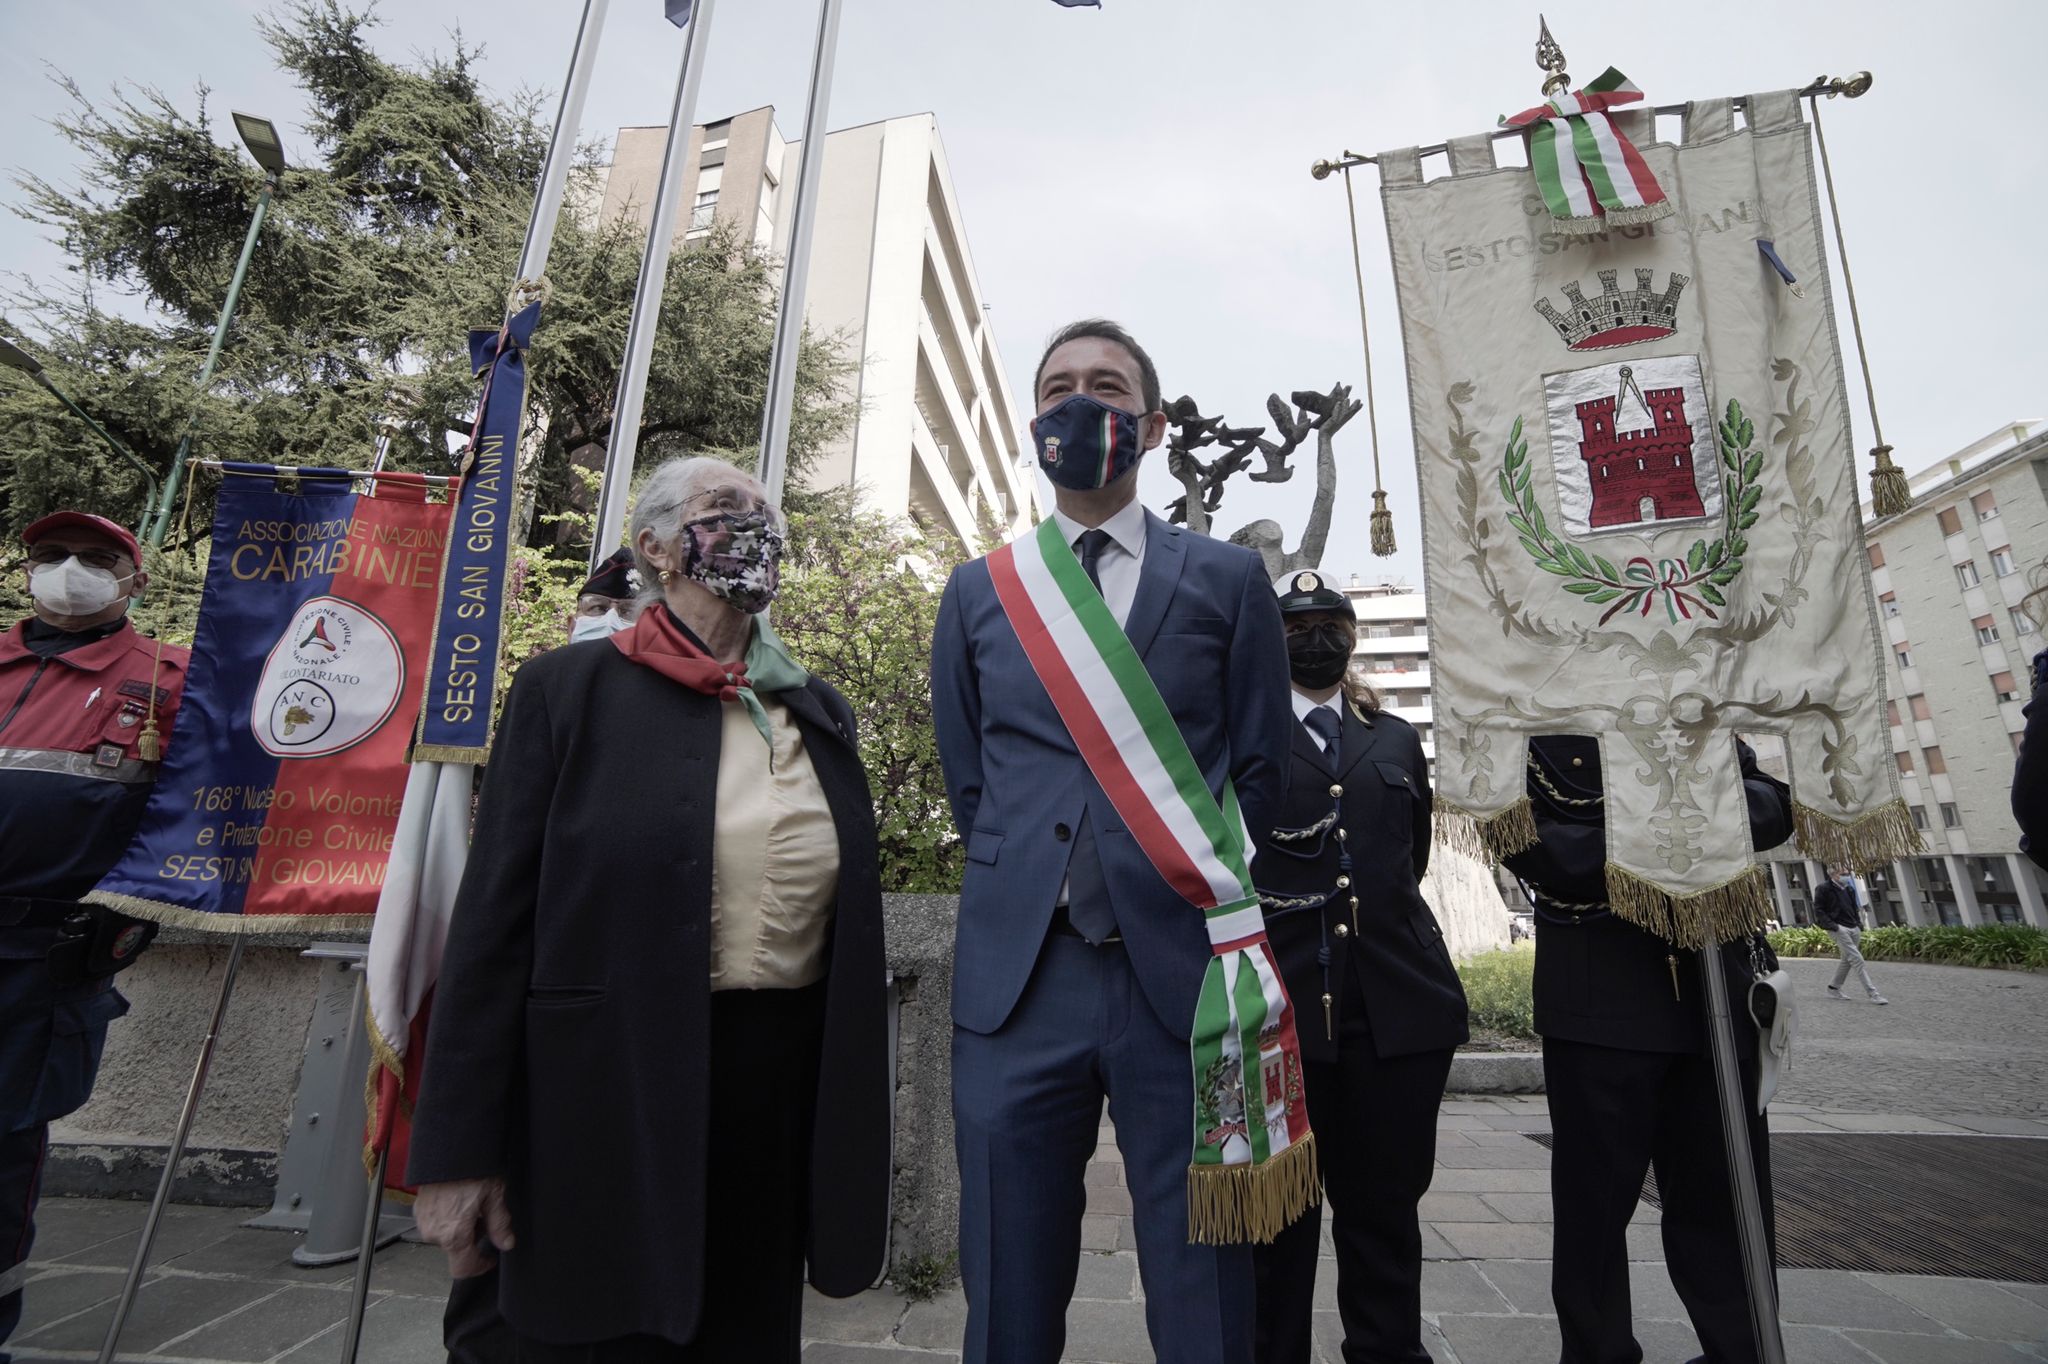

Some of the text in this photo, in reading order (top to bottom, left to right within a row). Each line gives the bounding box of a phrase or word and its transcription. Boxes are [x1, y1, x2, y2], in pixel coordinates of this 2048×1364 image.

[1424, 235, 1531, 272] SESTO
[238, 518, 447, 549] ASSOCIAZIONE NAZION
[231, 539, 437, 589] CARABINIE
[444, 434, 504, 723] SESTO SAN GIOVANNI
[294, 608, 352, 646] TEZIONE CIVILE
[292, 649, 341, 665] NAZONALE
[280, 667, 360, 686] LONTARIATO
[193, 786, 241, 812] 168°
[242, 784, 295, 811] Nucleo
[196, 821, 395, 853] e Protezione Civile
[158, 854, 236, 883] SESTO
[237, 856, 265, 884] SAN
